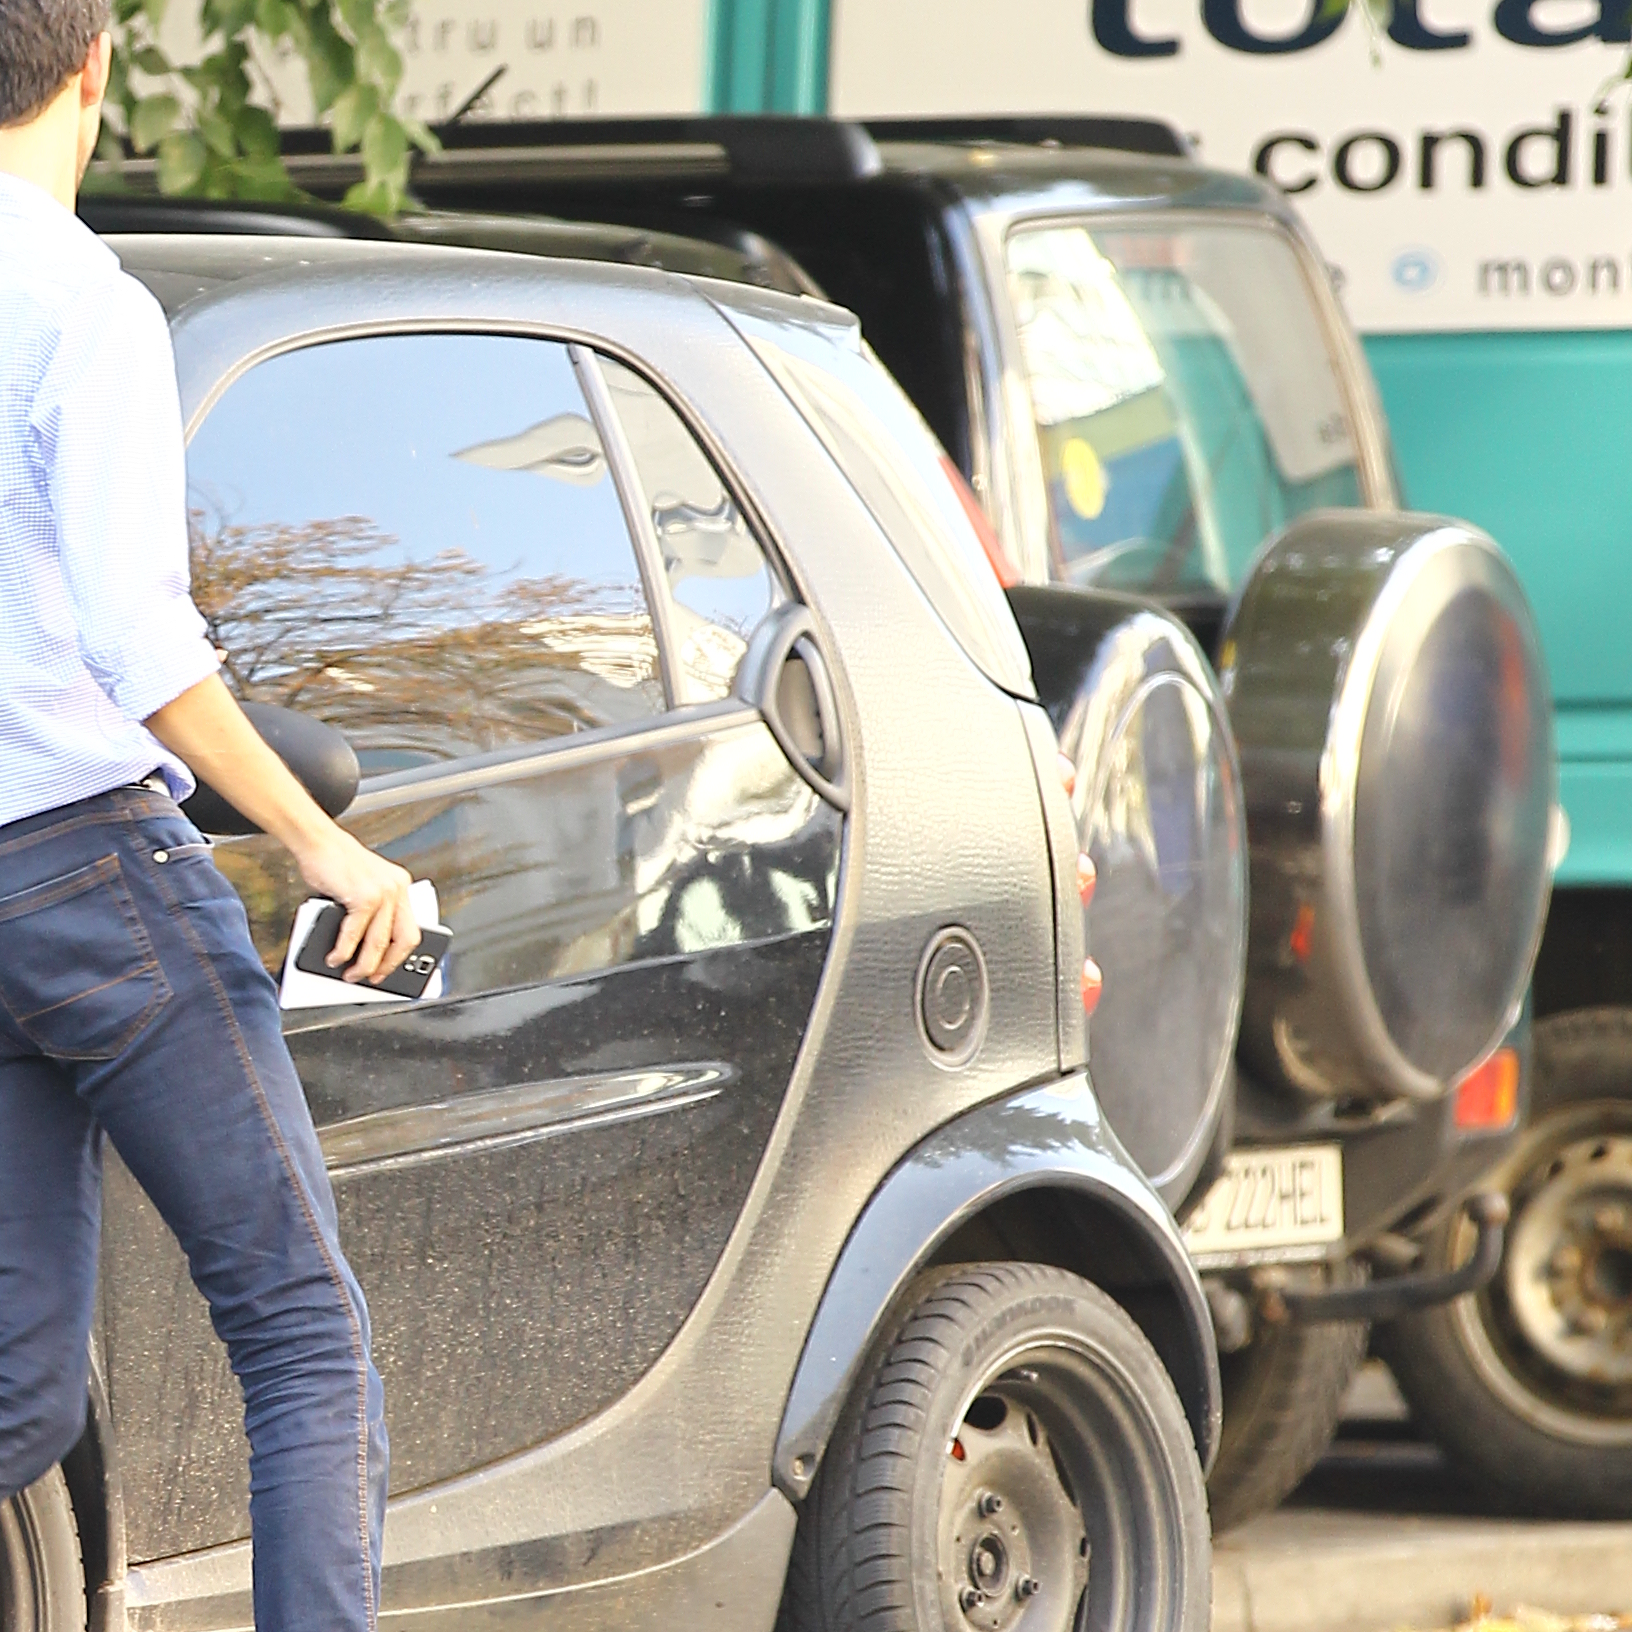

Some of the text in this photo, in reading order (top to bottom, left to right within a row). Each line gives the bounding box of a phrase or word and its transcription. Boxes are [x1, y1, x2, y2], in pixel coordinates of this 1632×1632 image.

[526, 14, 602, 51] un
[1253, 101, 1632, 194] condi
[1479, 255, 1632, 298] mon
